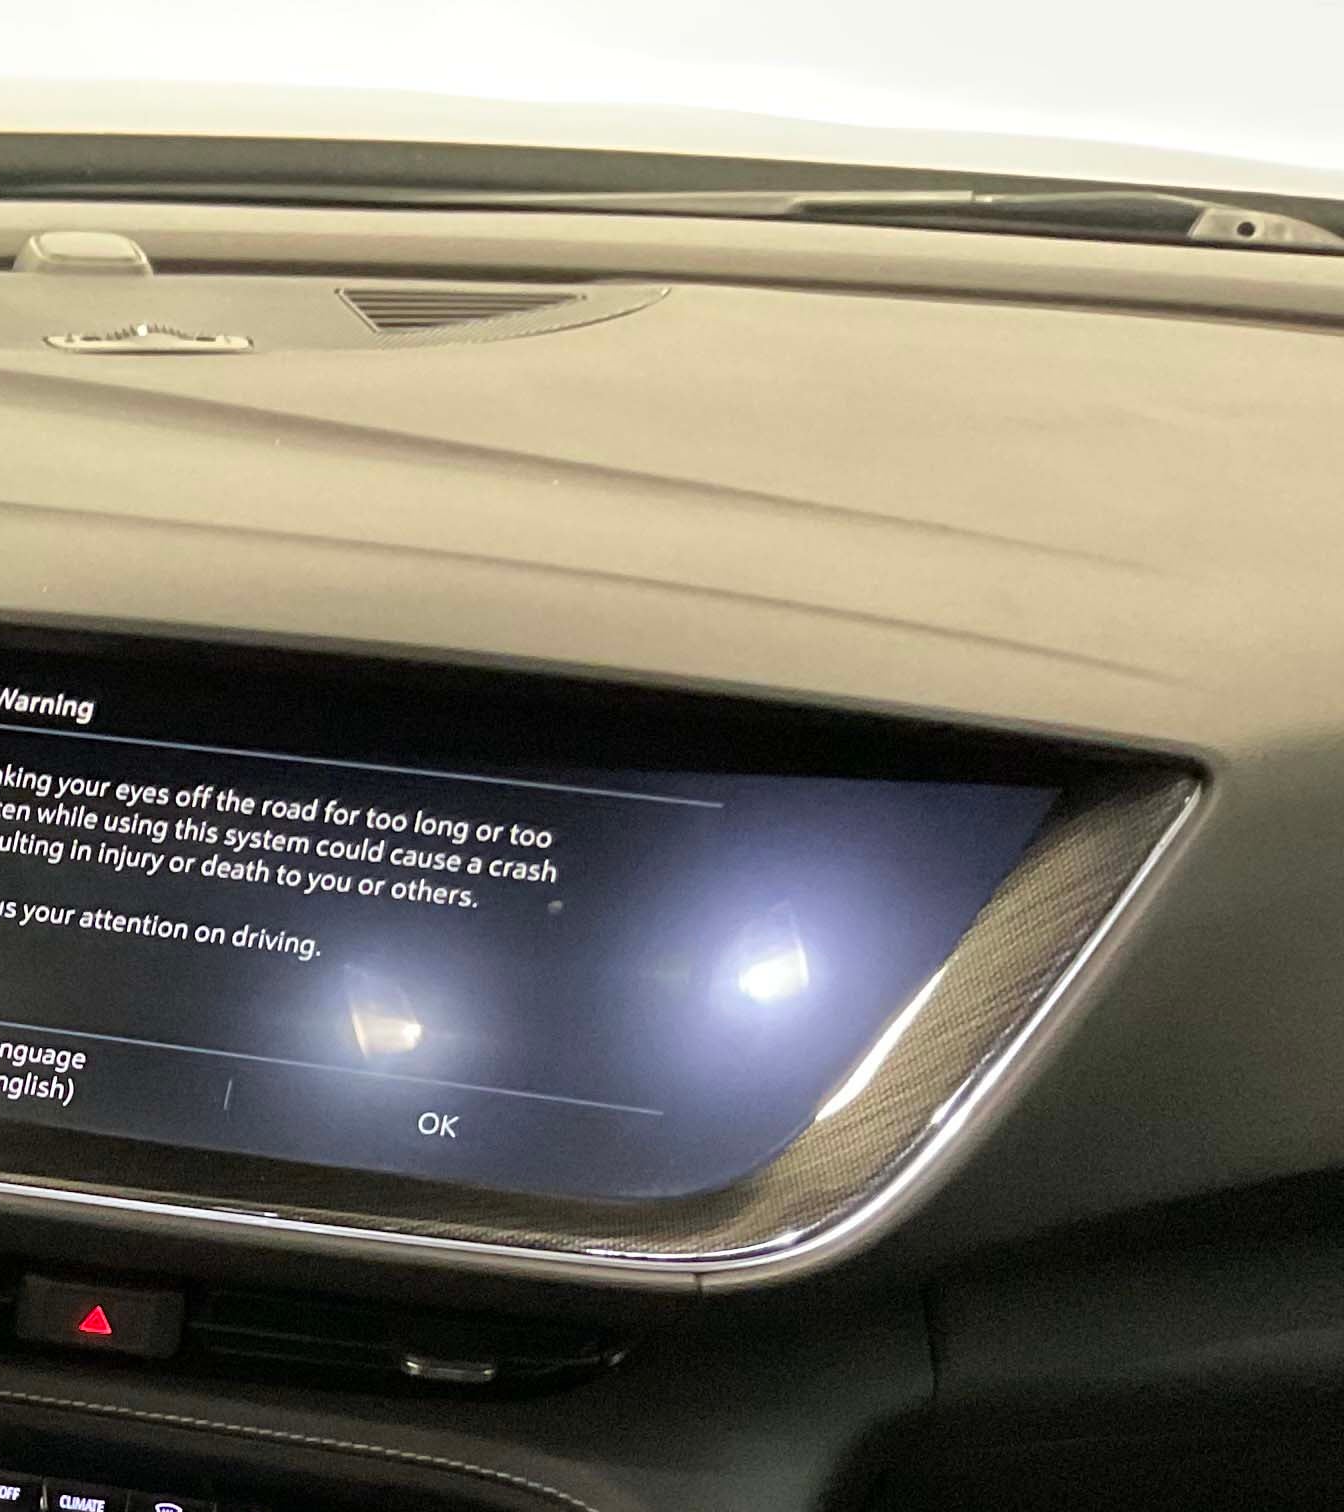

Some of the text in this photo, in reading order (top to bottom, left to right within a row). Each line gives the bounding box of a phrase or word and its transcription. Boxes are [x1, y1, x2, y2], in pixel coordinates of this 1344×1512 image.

[36, 803, 98, 830] while
[104, 812, 168, 843] using
[174, 816, 218, 845] this
[223, 826, 310, 855] system
[315, 839, 385, 863] could
[390, 848, 462, 872] cause
[466, 856, 482, 875] a
[488, 858, 557, 884] crash
[54, 777, 111, 799] your
[115, 783, 169, 807] eyes
[175, 784, 214, 809] off
[216, 788, 255, 814] the
[262, 799, 318, 822] road
[323, 800, 360, 826] for
[366, 807, 408, 832] too
[414, 811, 469, 845] long
[476, 823, 504, 842] or
[510, 824, 552, 848] too
[70, 840, 92, 861] in
[98, 843, 165, 876] injury
[169, 855, 195, 874] or
[201, 855, 270, 884] death
[276, 865, 302, 887] to
[304, 872, 351, 895] you
[358, 878, 385, 895] or
[391, 879, 478, 908] others.
[18, 903, 76, 927] your
[79, 906, 188, 941] attention
[194, 923, 225, 945] on
[231, 924, 321, 960] driving.
[416, 1111, 460, 1139] OK
